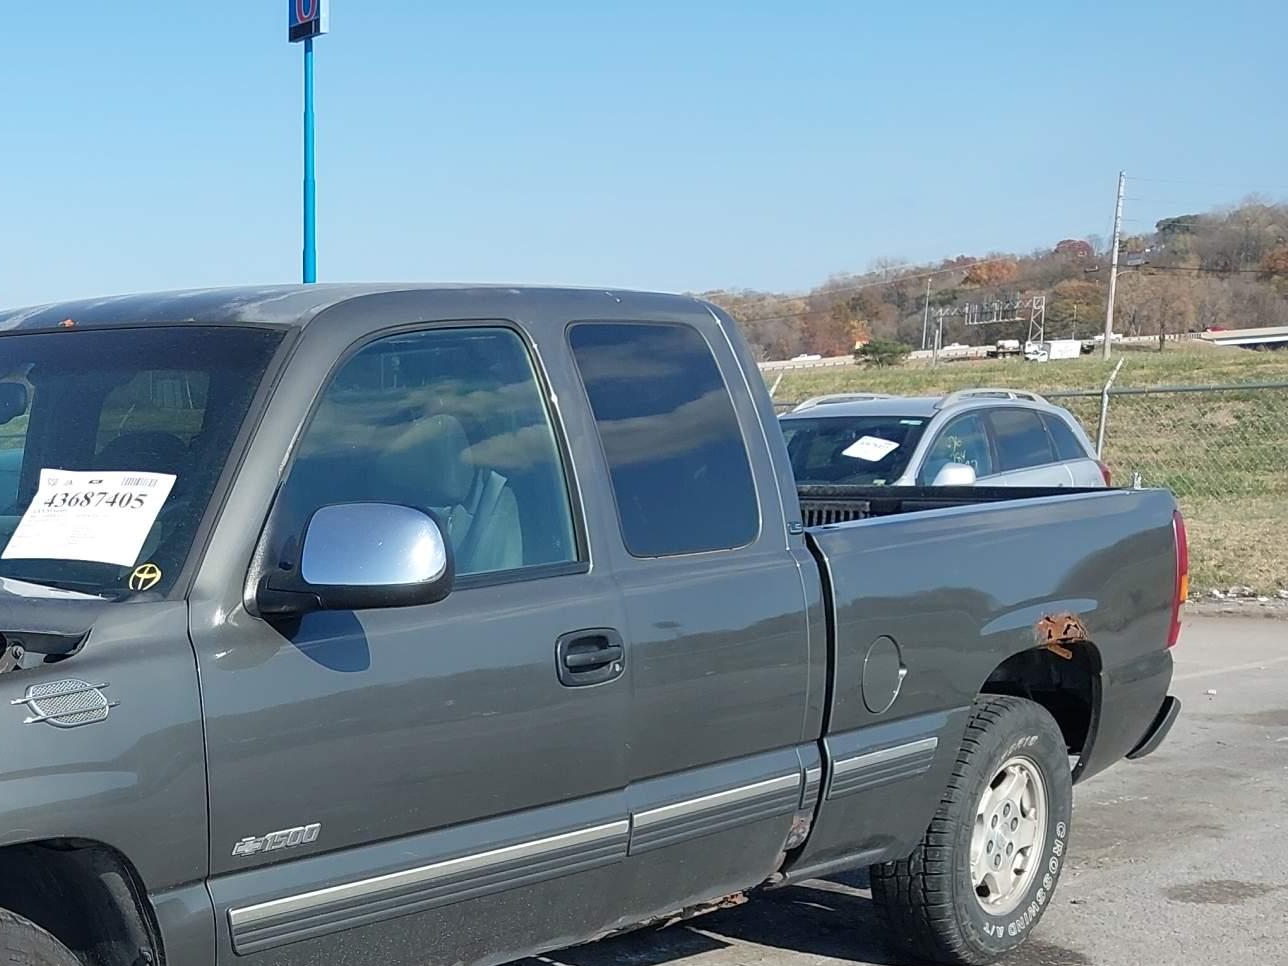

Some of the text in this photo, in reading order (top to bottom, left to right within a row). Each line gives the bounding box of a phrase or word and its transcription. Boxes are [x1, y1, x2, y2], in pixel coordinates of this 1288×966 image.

[44, 491, 148, 509] 43687405
[262, 823, 322, 851] 1500
[1008, 822, 1067, 937] CROSSWIND
